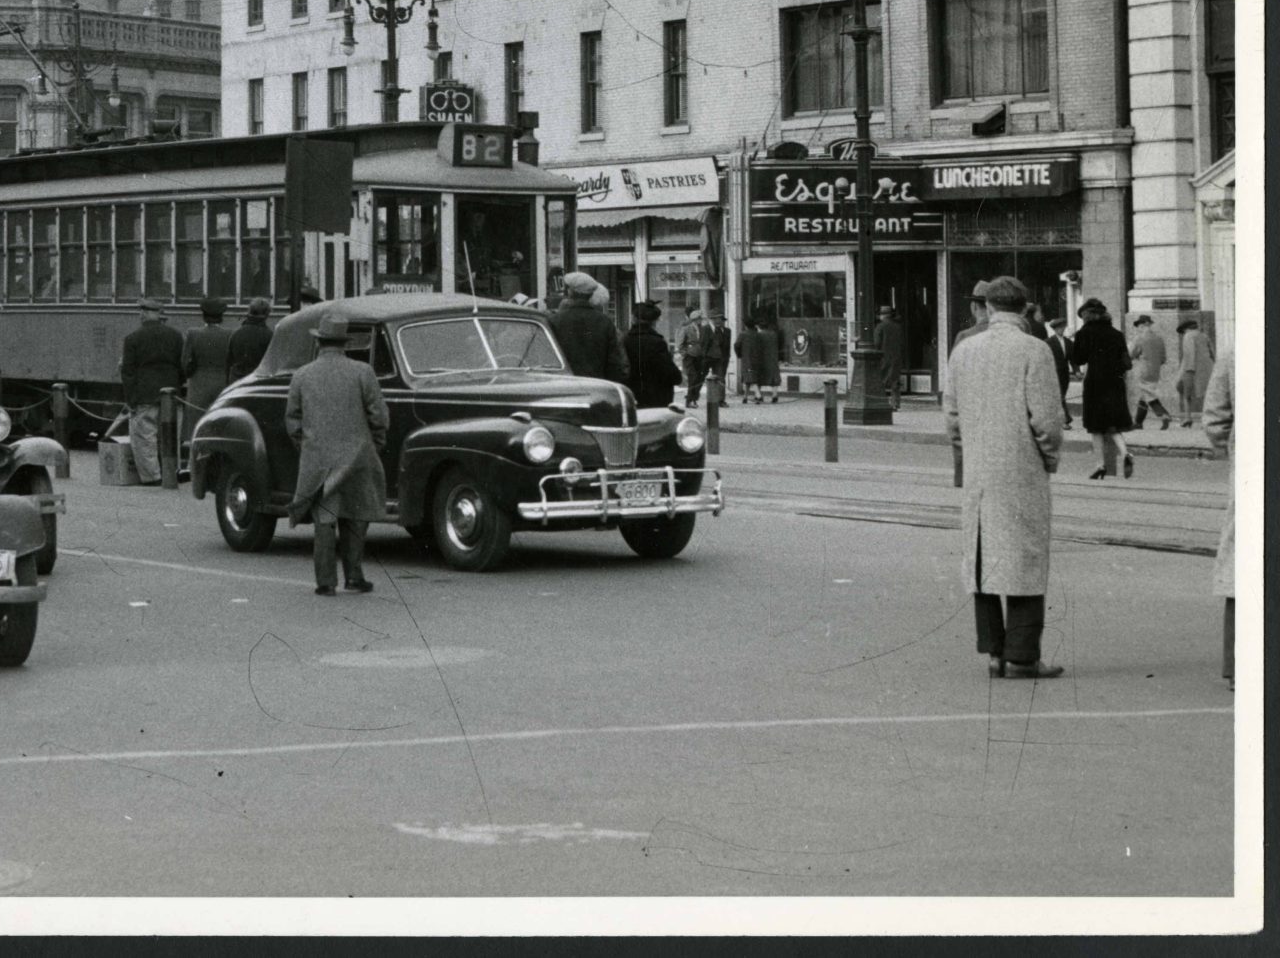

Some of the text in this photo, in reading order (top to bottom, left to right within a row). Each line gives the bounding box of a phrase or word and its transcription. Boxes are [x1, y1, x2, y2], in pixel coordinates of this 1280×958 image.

[647, 173, 706, 190] PASTRIES
[933, 164, 1051, 189] LUNCHEONETTE
[784, 217, 912, 234] RESTAUANT
